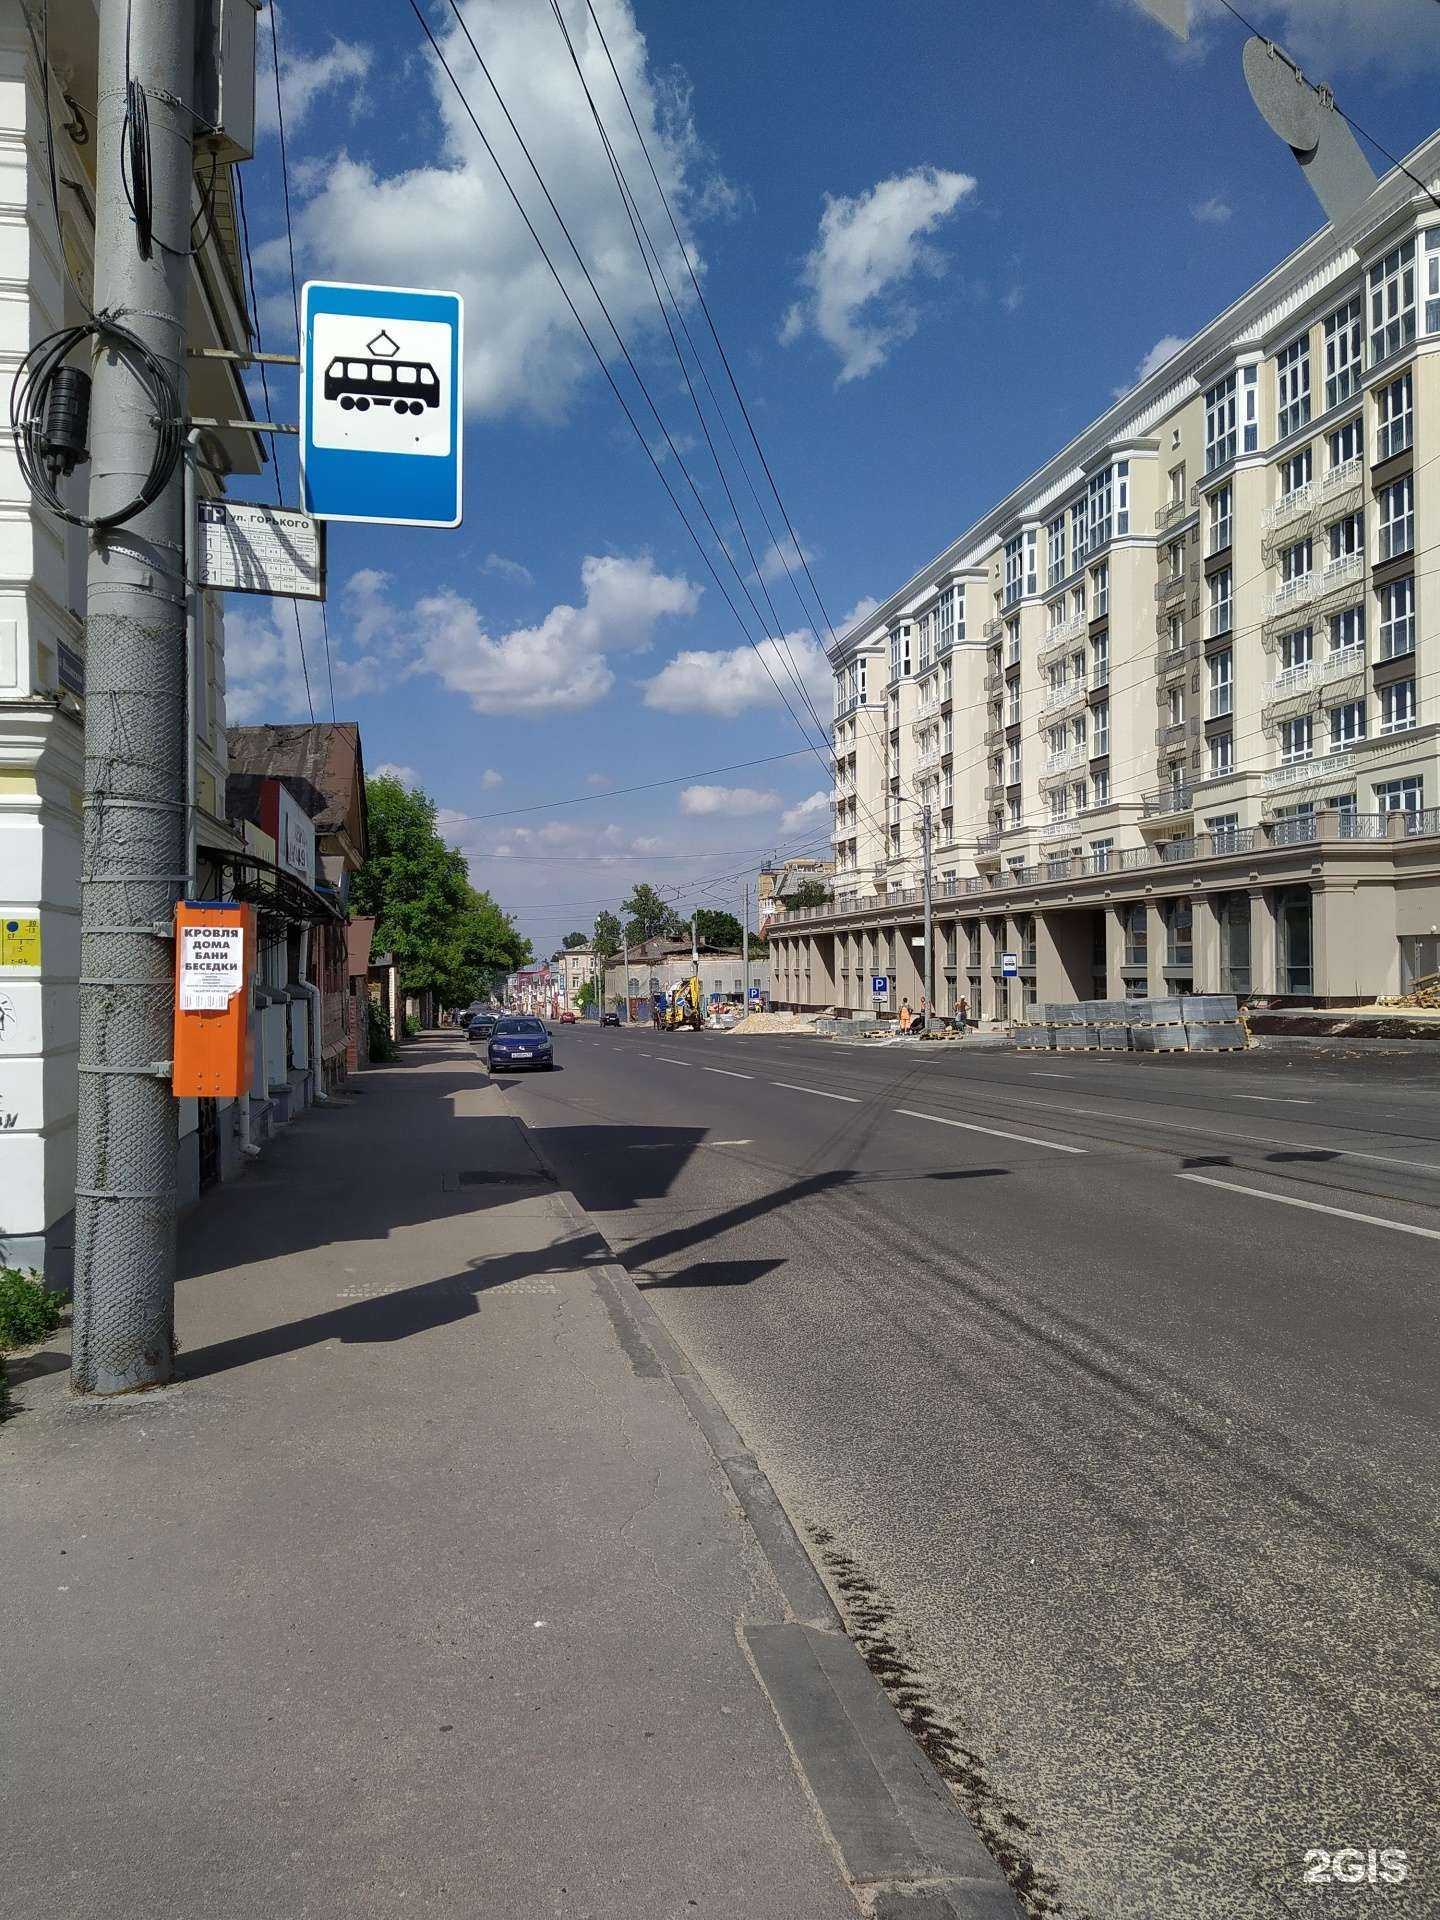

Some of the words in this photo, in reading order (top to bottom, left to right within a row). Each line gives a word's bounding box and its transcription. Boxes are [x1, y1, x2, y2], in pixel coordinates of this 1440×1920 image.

[250, 515, 310, 529] ГОРЬКОГО
[205, 553, 214, 565] 2
[201, 568, 217, 581] 21
[184, 928, 239, 938] КРОВЛЯ
[192, 941, 230, 949] ДОМА
[195, 951, 228, 960] БАНИ
[185, 962, 238, 972] БЕСЕДКИ
[875, 979, 884, 990] P
